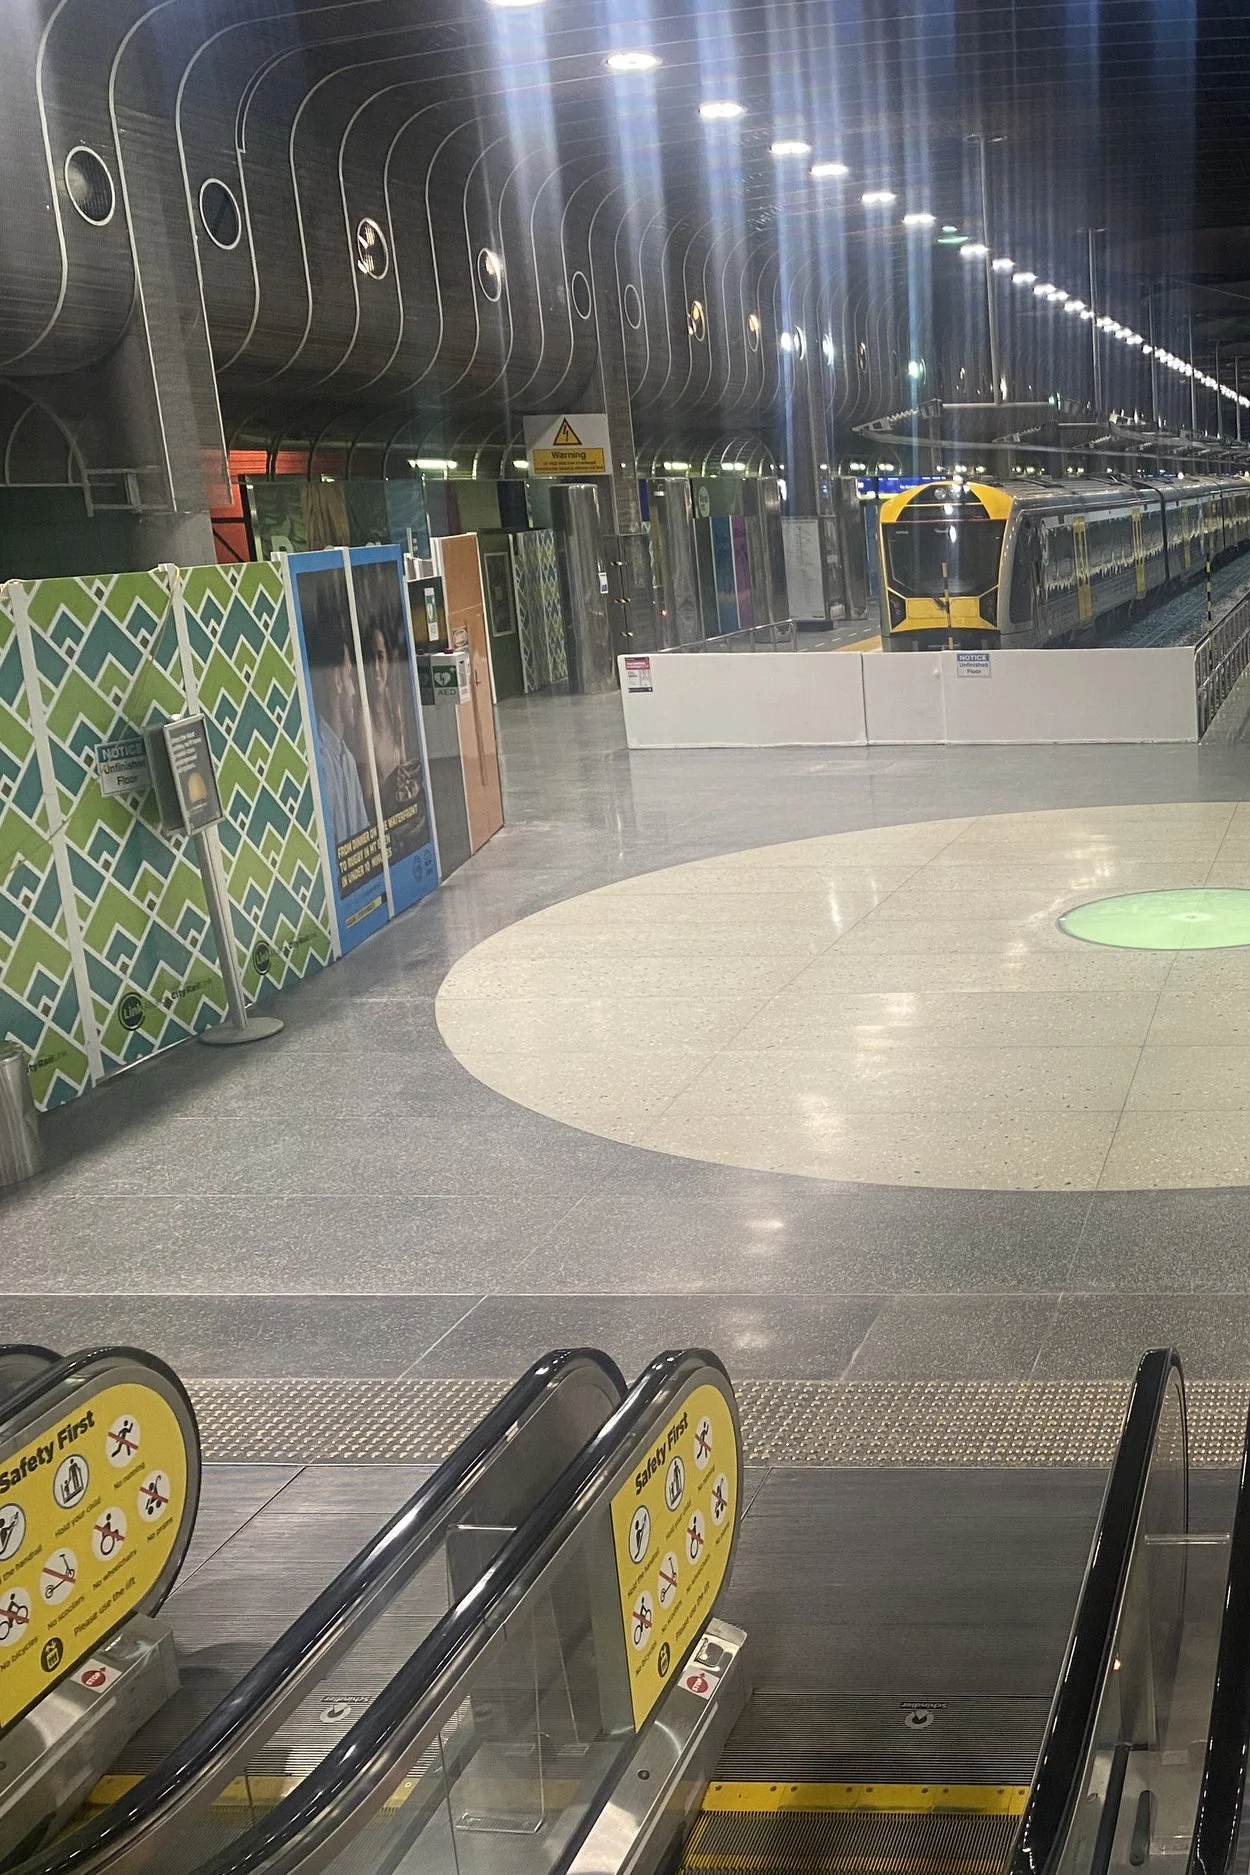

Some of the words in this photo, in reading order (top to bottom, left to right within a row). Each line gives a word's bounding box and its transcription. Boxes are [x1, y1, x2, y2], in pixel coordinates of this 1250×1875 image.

[551, 450, 587, 460] Warning
[438, 688, 457, 696] AED
[0, 1440, 55, 1494] Safety
[56, 1410, 96, 1451] First
[635, 1441, 667, 1496] Safety
[667, 1411, 690, 1452] First
[55, 1521, 72, 1538] Hold
[72, 1509, 87, 1528] your
[92, 1579, 103, 1591] No
[47, 1618, 59, 1631] No
[58, 1594, 86, 1623] scooters
[73, 1611, 99, 1637] Please
[98, 1600, 113, 1616] use
[112, 1589, 125, 1606] the
[125, 1574, 137, 1594] lift
[11, 1635, 39, 1659] bicycles
[86, 1671, 101, 1686] STOP
[691, 1677, 704, 1692] STOP
